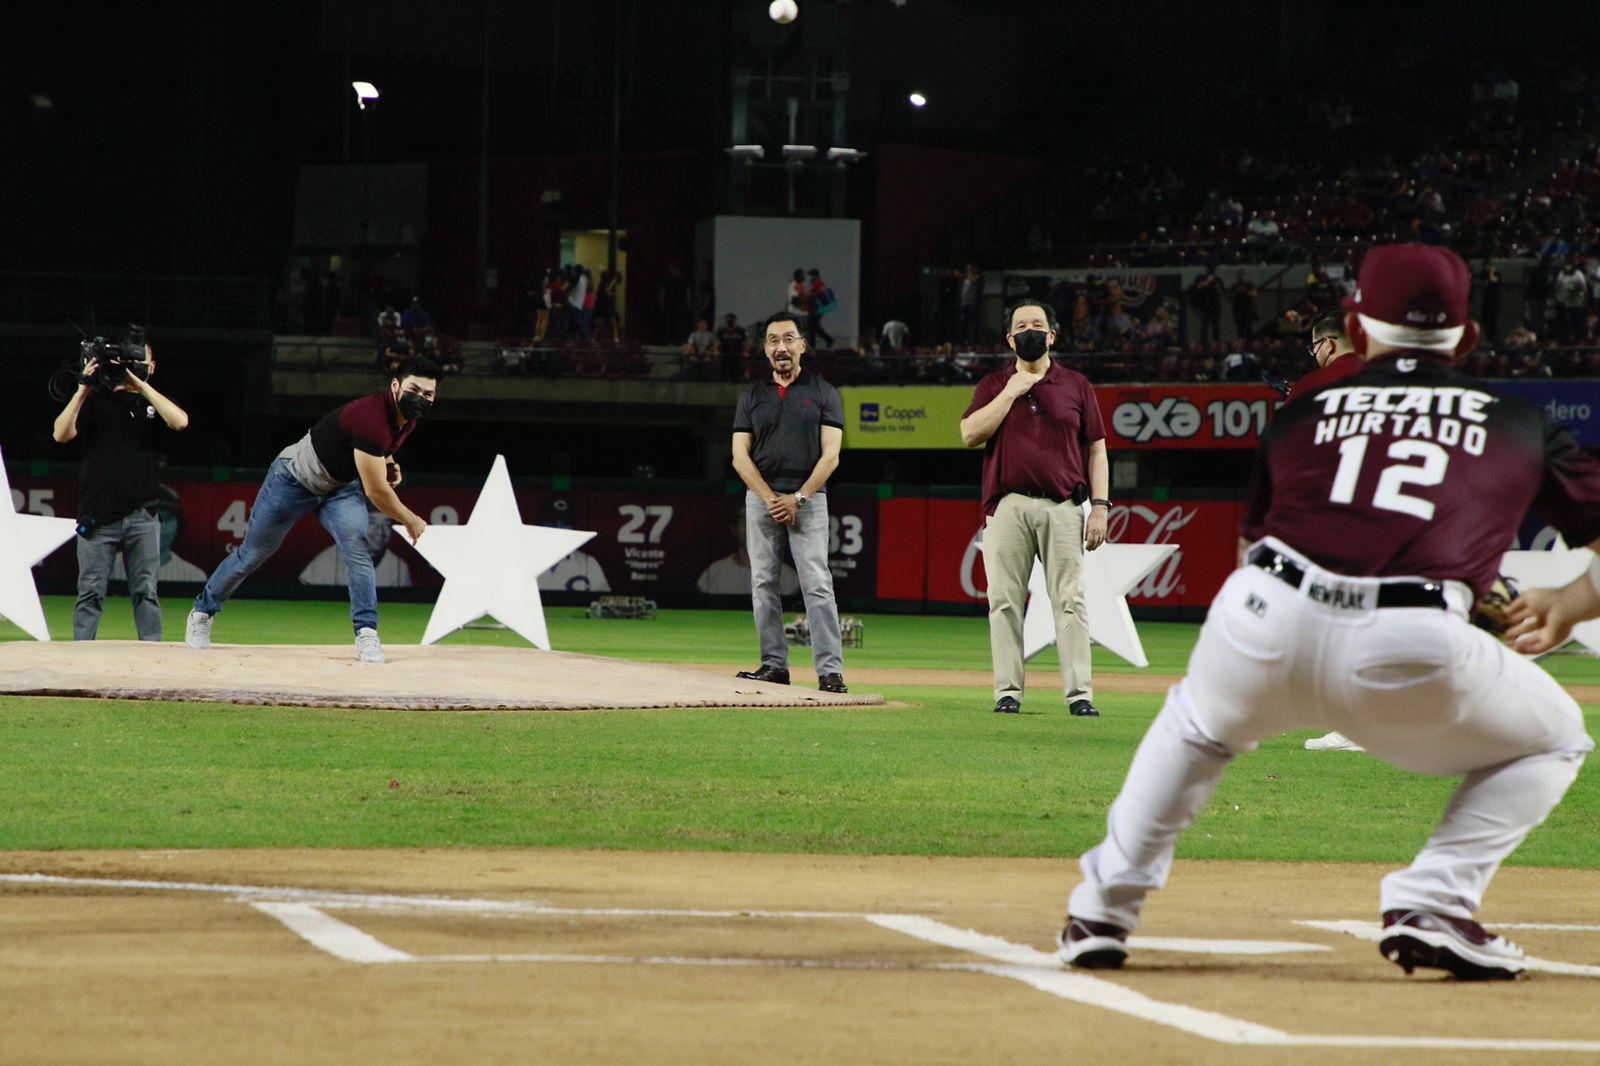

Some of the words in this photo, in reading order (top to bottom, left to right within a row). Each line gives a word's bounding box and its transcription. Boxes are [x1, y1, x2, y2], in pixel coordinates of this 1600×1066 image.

[884, 405, 926, 421] Coppel
[1314, 386, 1492, 423] TECATE
[1314, 412, 1487, 456] HURTADO
[1329, 434, 1450, 521] 12
[617, 504, 673, 543] 27
